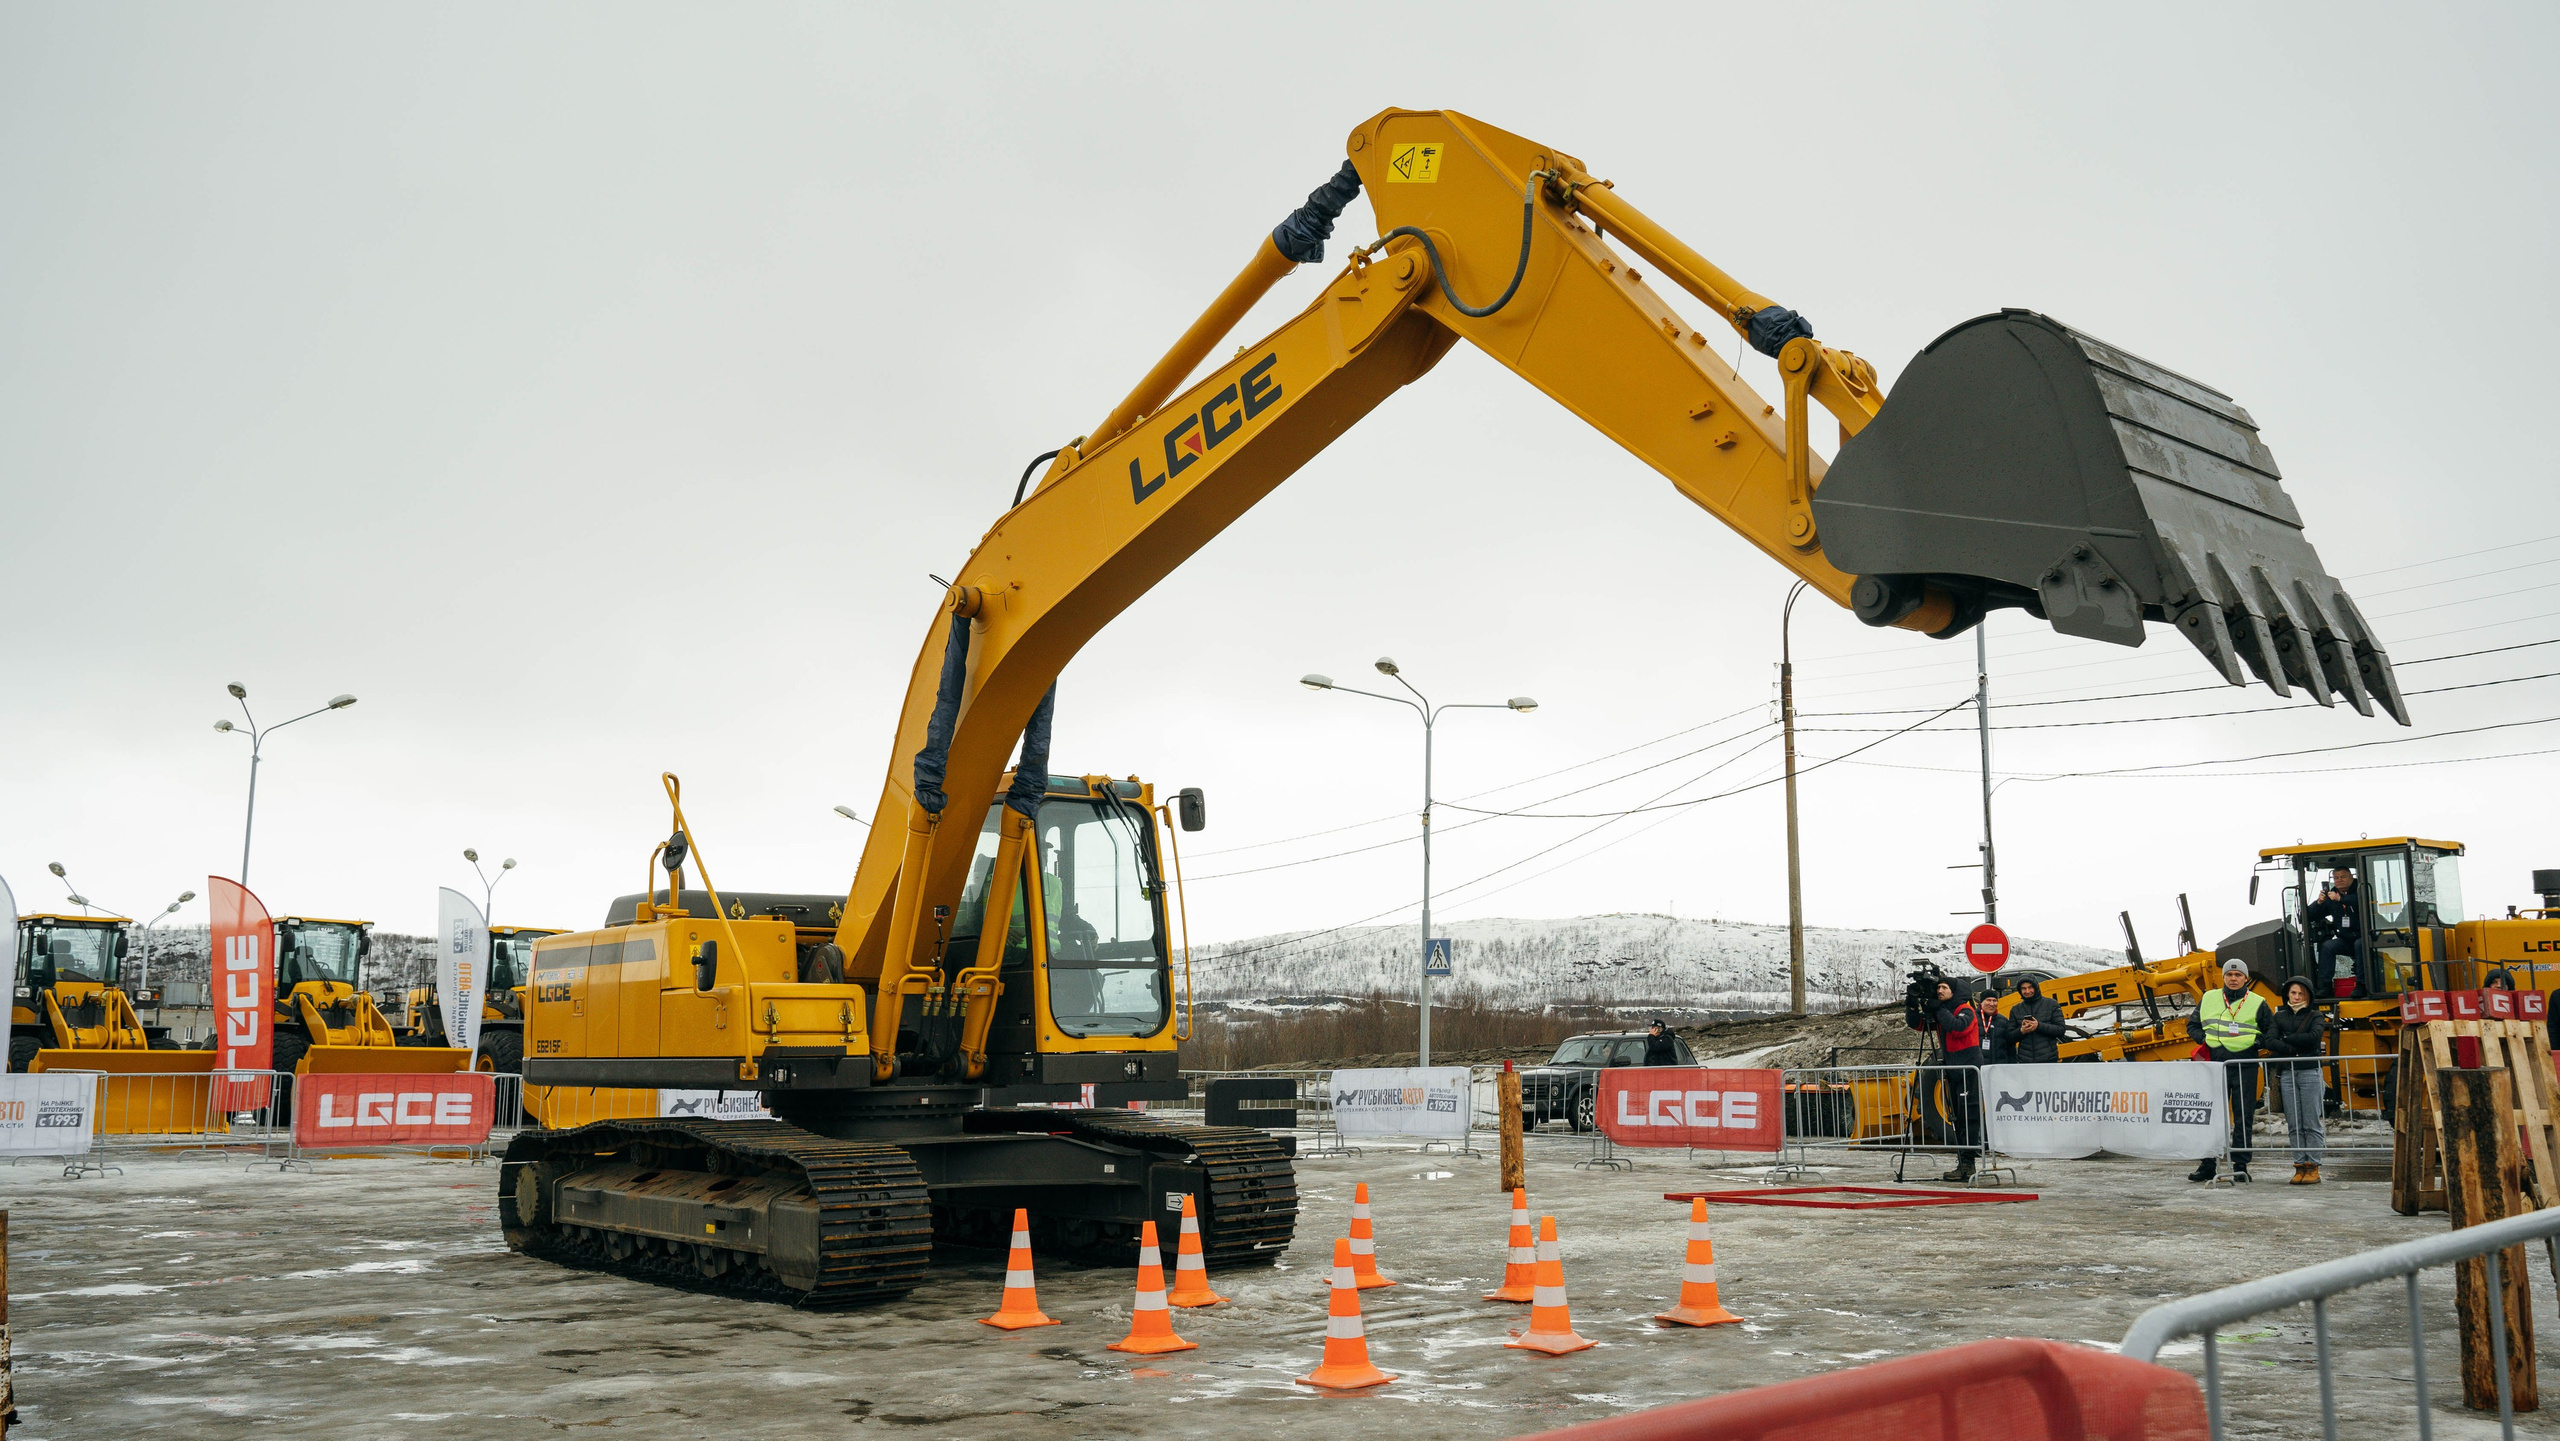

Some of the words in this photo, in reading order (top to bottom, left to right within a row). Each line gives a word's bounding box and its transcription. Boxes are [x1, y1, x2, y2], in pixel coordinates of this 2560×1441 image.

[1129, 352, 1283, 505] LGCE
[538, 982, 571, 1003] LGCE
[2052, 983, 2119, 1007] LGCE
[2457, 996, 2477, 1014] L
[704, 1097, 762, 1113] РУСБИЗНЕС
[1358, 1087, 1425, 1106] РУСБИЗНЕСАВТО
[2035, 1091, 2149, 1114] РУСБИЗНЕСАВТО
[2163, 1099, 2213, 1107] АВТОТЕХНИКИ
[319, 1092, 473, 1128] LGCE
[1617, 1090, 1758, 1129] LGCE
[2097, 1115, 2150, 1123] ЗАПЧАСТИ
